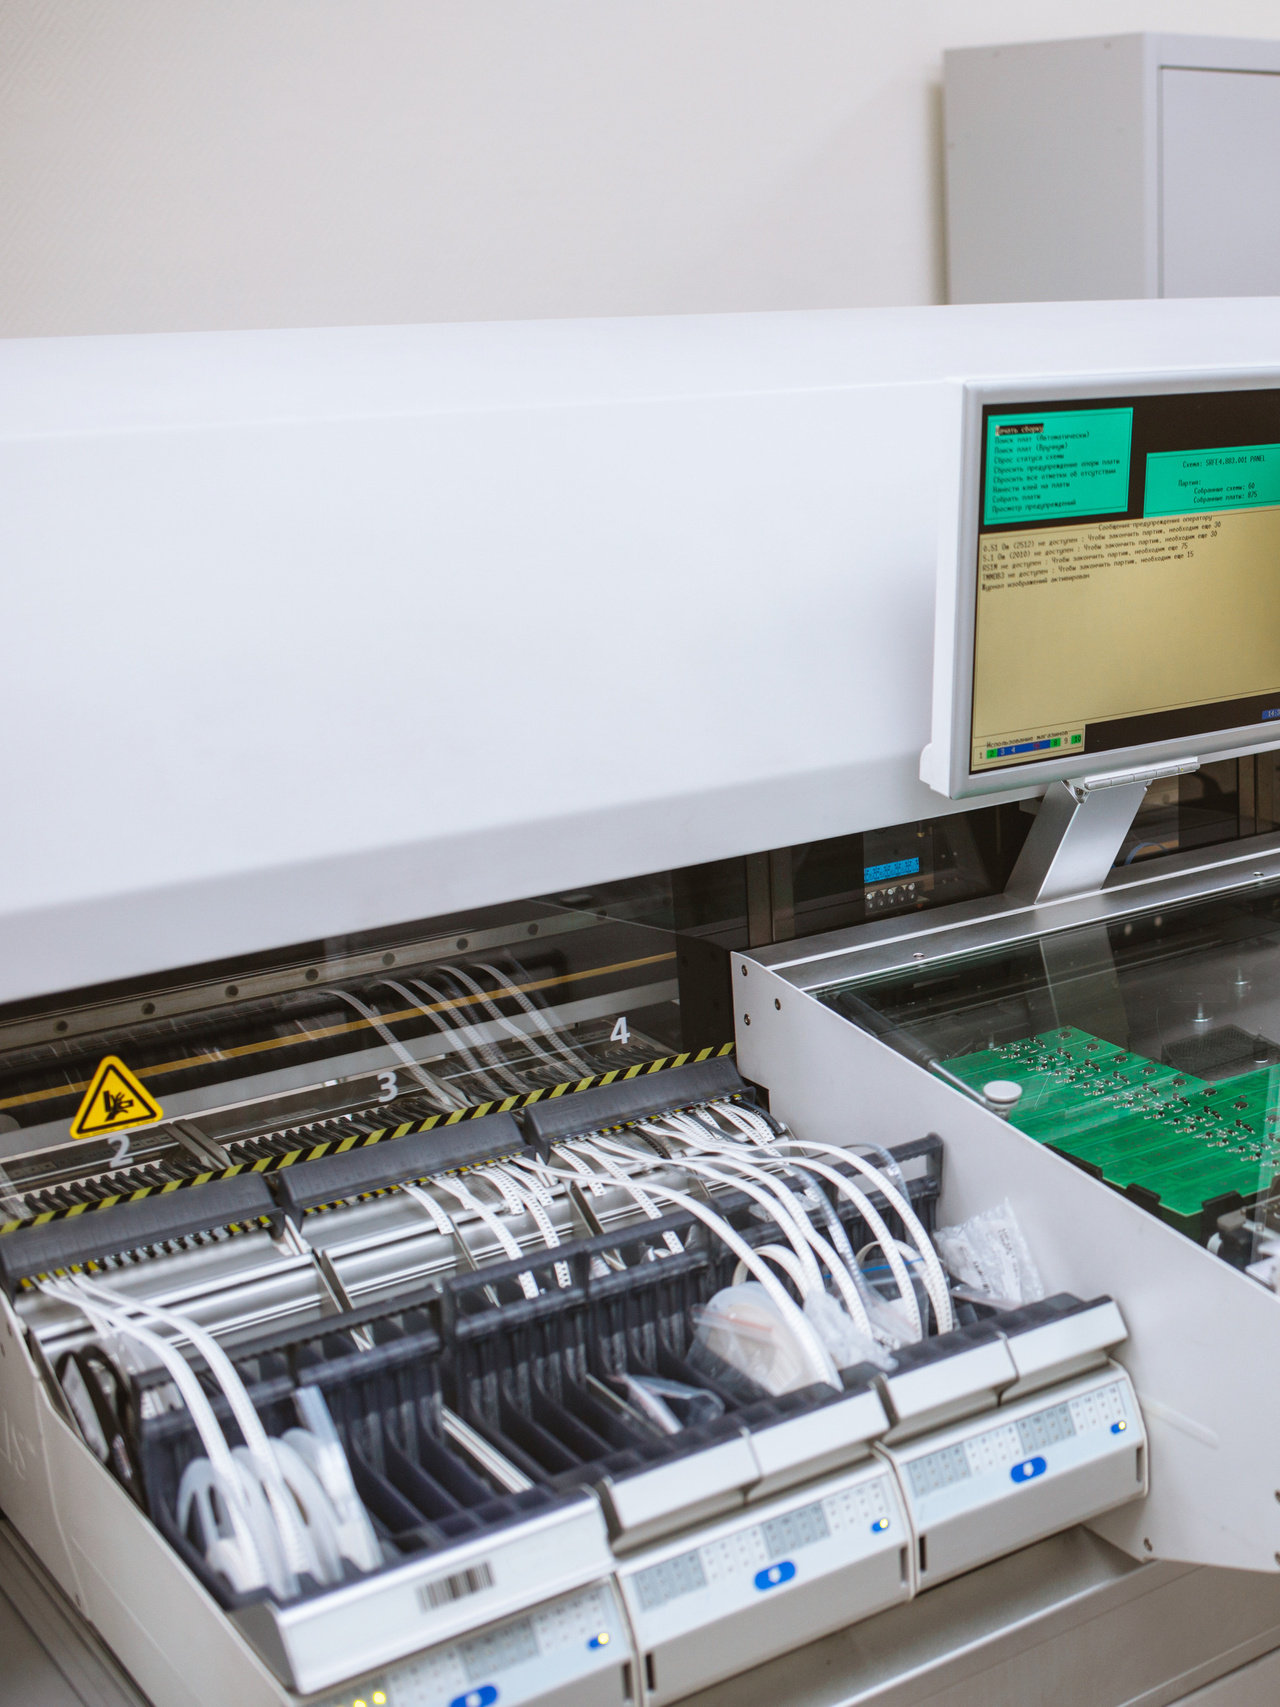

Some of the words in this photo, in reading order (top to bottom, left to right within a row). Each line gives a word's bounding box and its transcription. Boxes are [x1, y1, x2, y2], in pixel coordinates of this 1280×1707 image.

[994, 446, 1013, 454] Поиск
[994, 457, 1012, 465] Сброс
[1017, 455, 1042, 463] статуса
[993, 466, 1024, 475] Сбросить
[993, 476, 1024, 485] Сбросить
[1041, 472, 1067, 480] отметки
[992, 485, 1019, 494] Нанести
[992, 495, 1019, 504] Собрать
[992, 504, 1022, 514] Просмотр
[1049, 538, 1078, 547] доступен
[1045, 547, 1074, 556] доступен
[1012, 560, 1041, 569] доступен
[1019, 568, 1048, 578] доступен
[610, 1016, 630, 1044] 4
[377, 1071, 398, 1102] 3
[108, 1134, 134, 1168] 2
